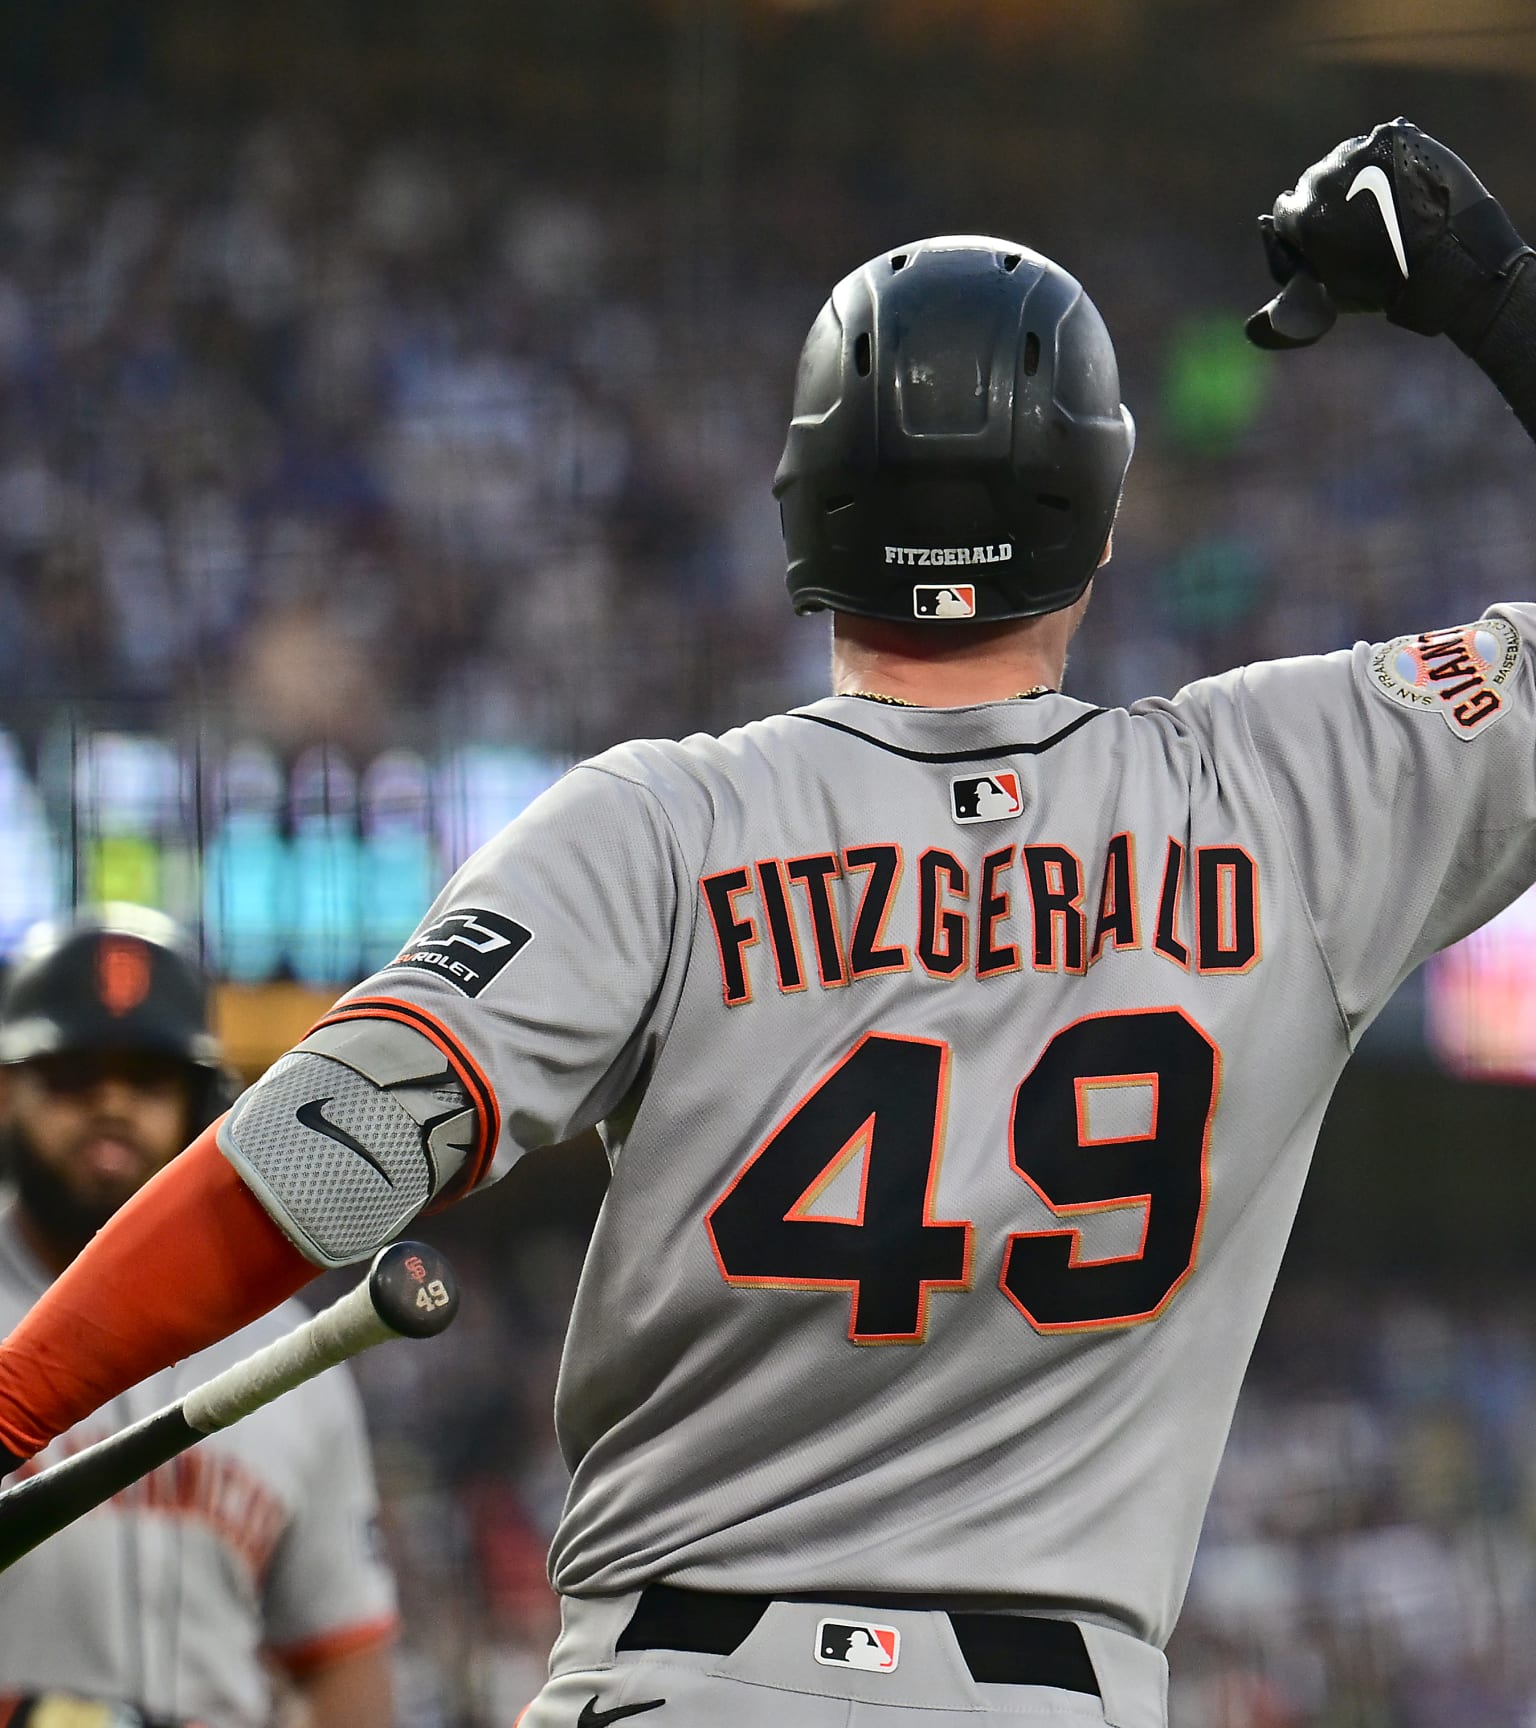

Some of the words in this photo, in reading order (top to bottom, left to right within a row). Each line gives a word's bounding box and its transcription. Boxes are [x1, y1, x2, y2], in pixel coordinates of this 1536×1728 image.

[884, 543, 1013, 566] FITZGERALD
[1396, 688, 1433, 706] SAN
[1417, 628, 1502, 729] GIANT
[699, 830, 1263, 1009] FITZGERALD
[704, 1004, 1244, 1347] 49
[415, 1280, 450, 1312] 49
